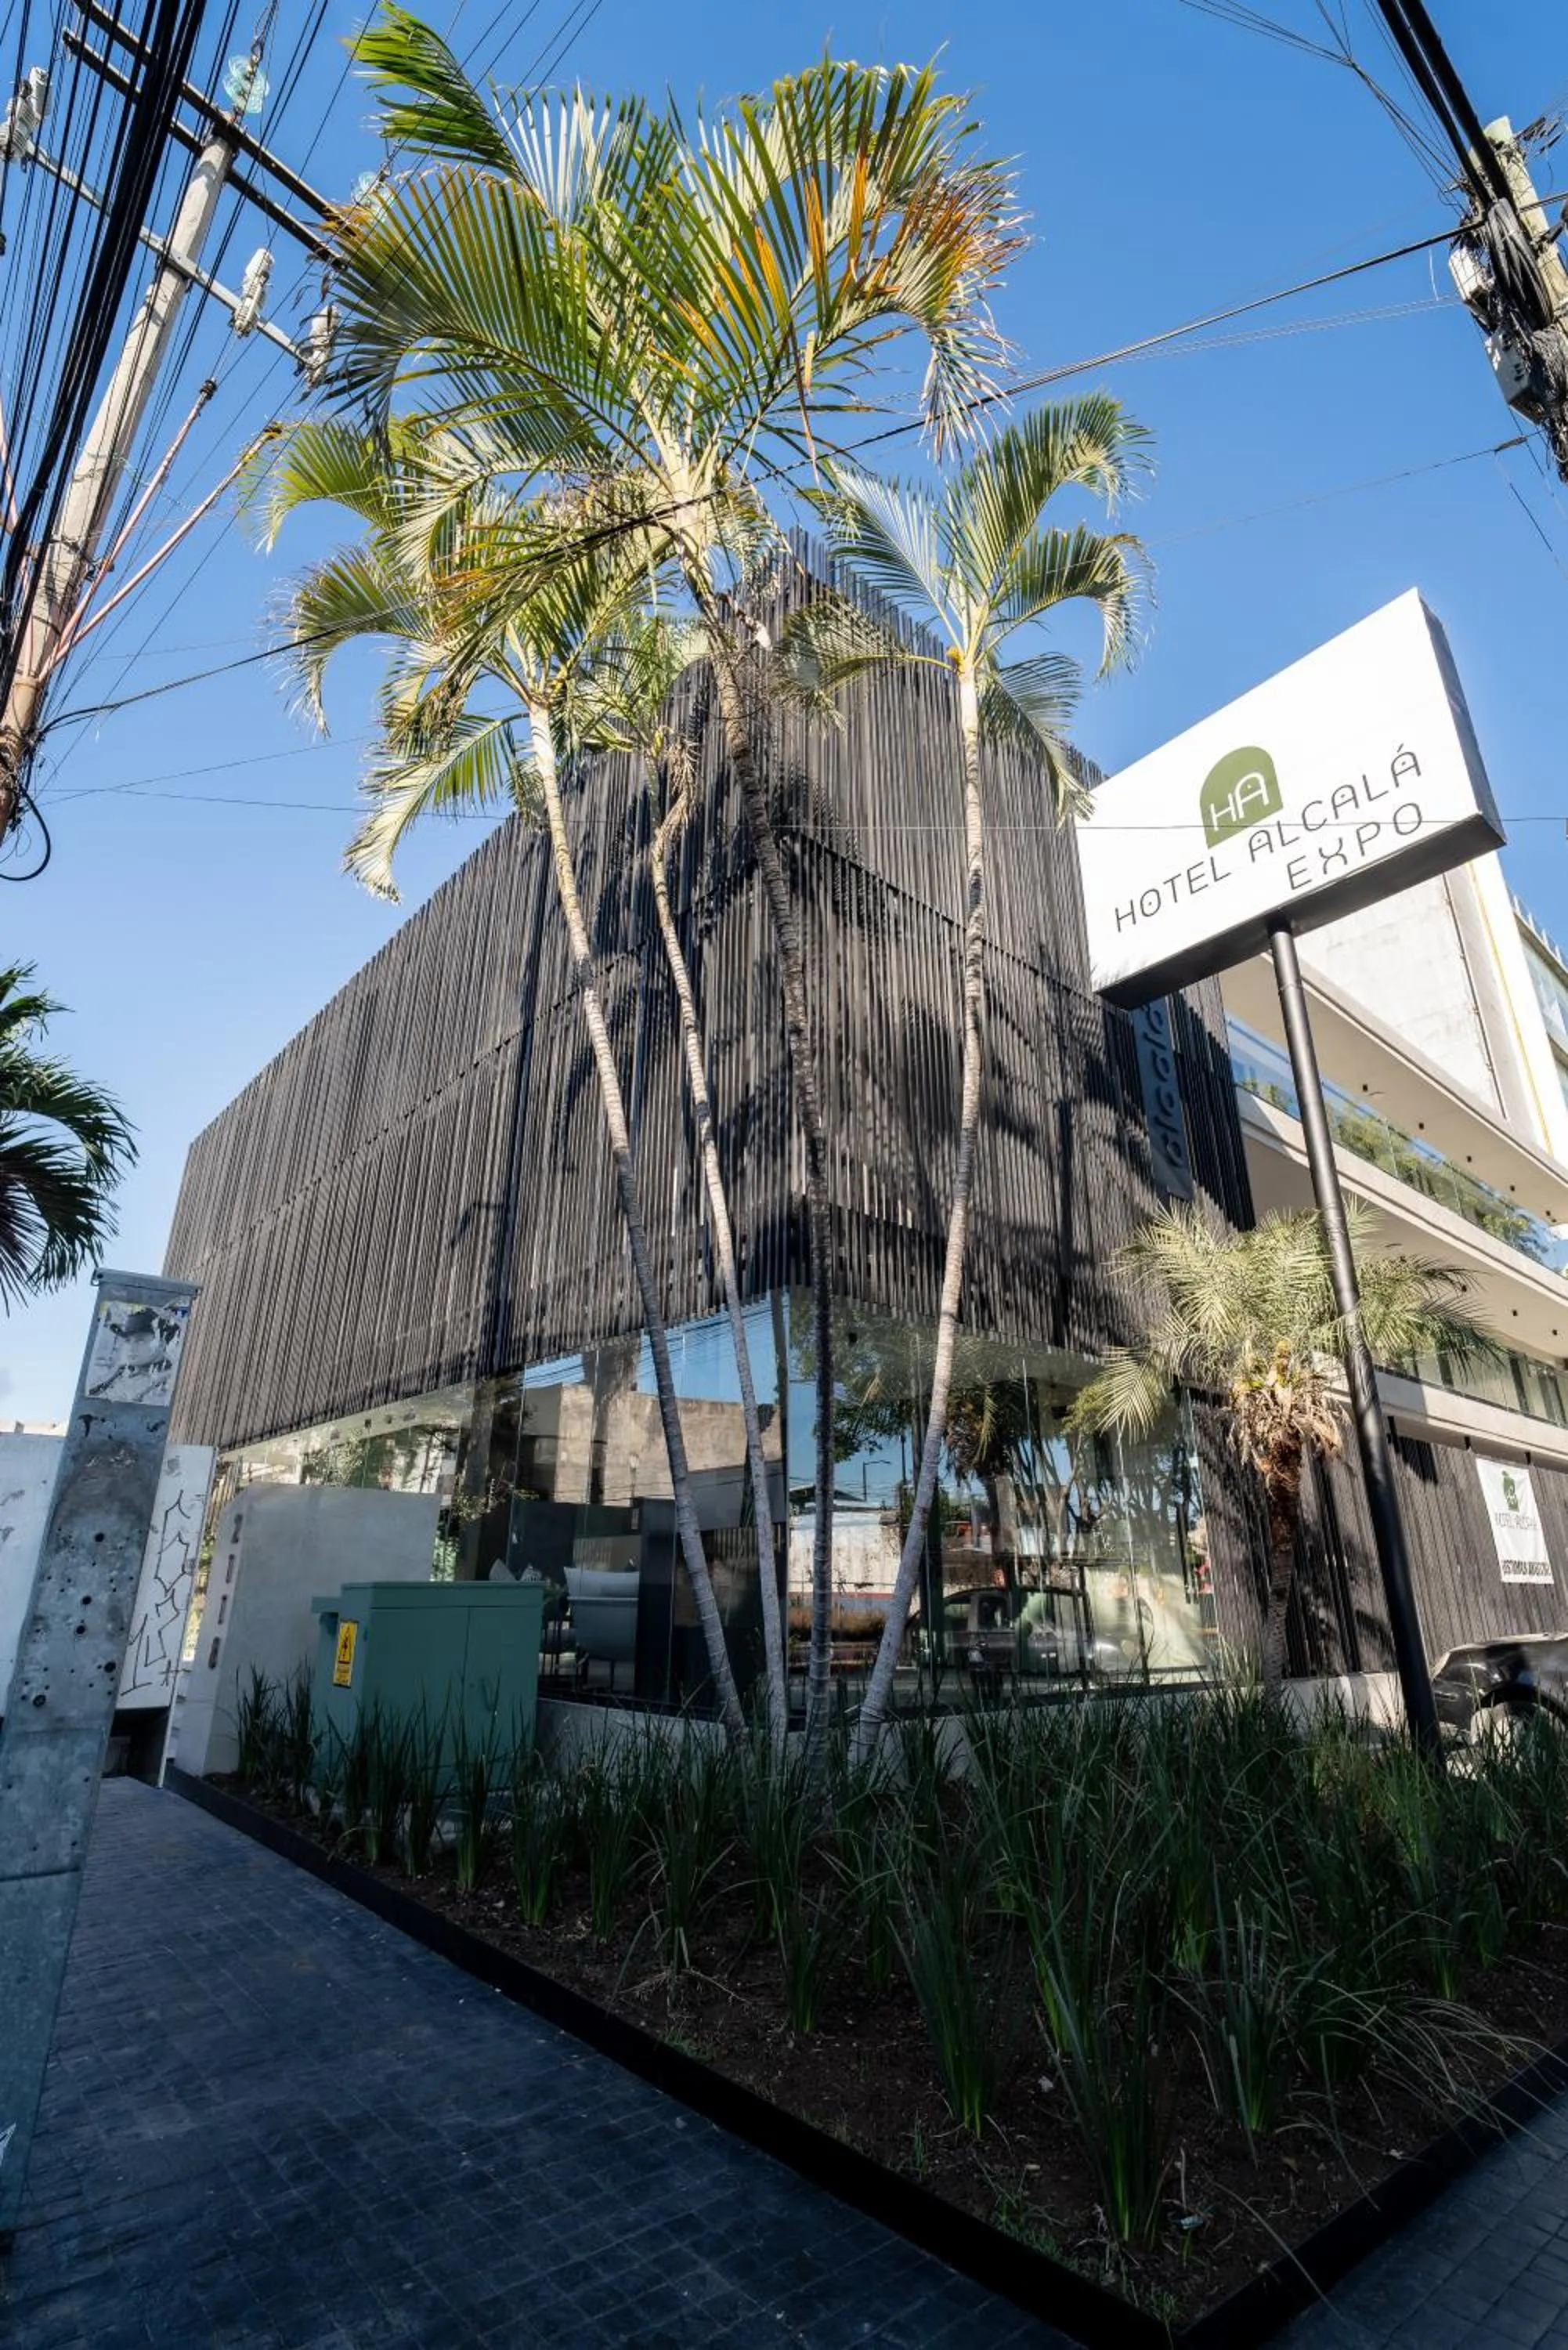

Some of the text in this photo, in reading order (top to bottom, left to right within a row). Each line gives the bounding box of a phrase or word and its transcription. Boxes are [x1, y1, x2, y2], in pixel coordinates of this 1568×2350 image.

[1114, 743, 1423, 933] HOTEL ALCALÁ
[1209, 772, 1270, 832] HA
[1286, 801, 1424, 891] EXPO
